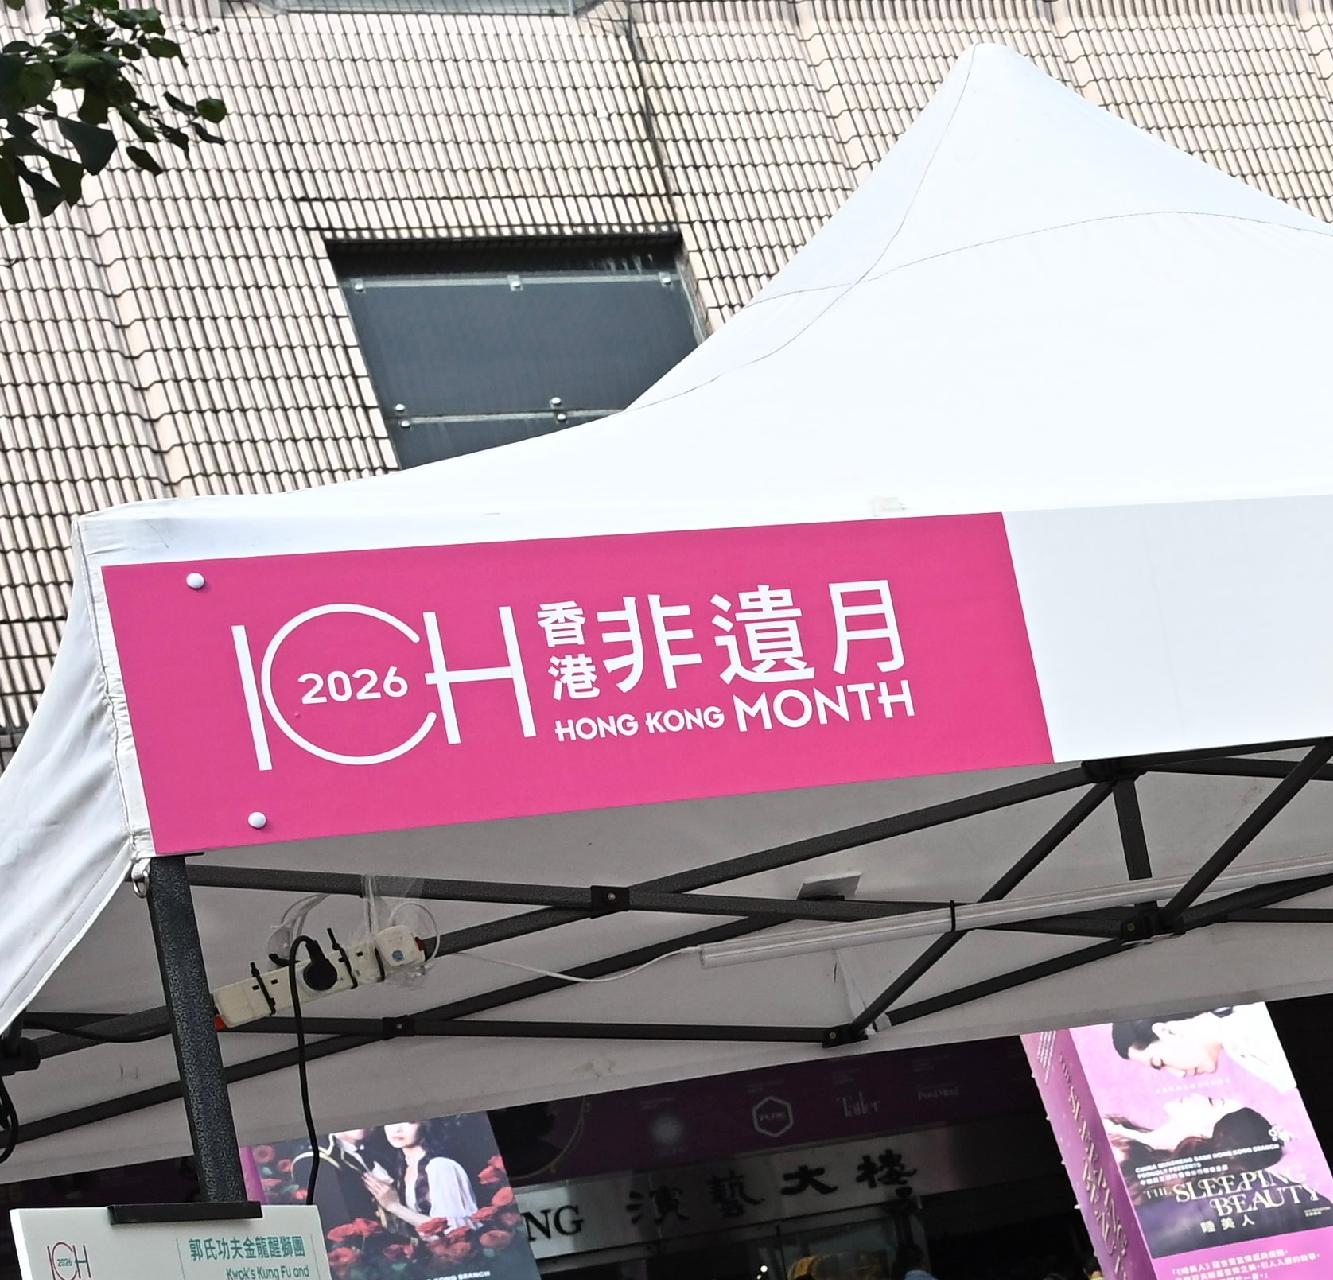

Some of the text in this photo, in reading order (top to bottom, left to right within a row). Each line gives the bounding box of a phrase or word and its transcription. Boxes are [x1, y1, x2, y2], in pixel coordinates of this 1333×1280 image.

[538, 580, 908, 701] 香港 非遺月
[231, 603, 537, 771] ICH
[297, 666, 408, 706] 2026
[554, 680, 915, 741] HONG KONG MONTH
[627, 1150, 915, 1225] 演藝大樓
[1209, 1184, 1320, 1217] BEAUTY
[280, 1266, 292, 1279] Fu
[292, 1264, 310, 1278] and
